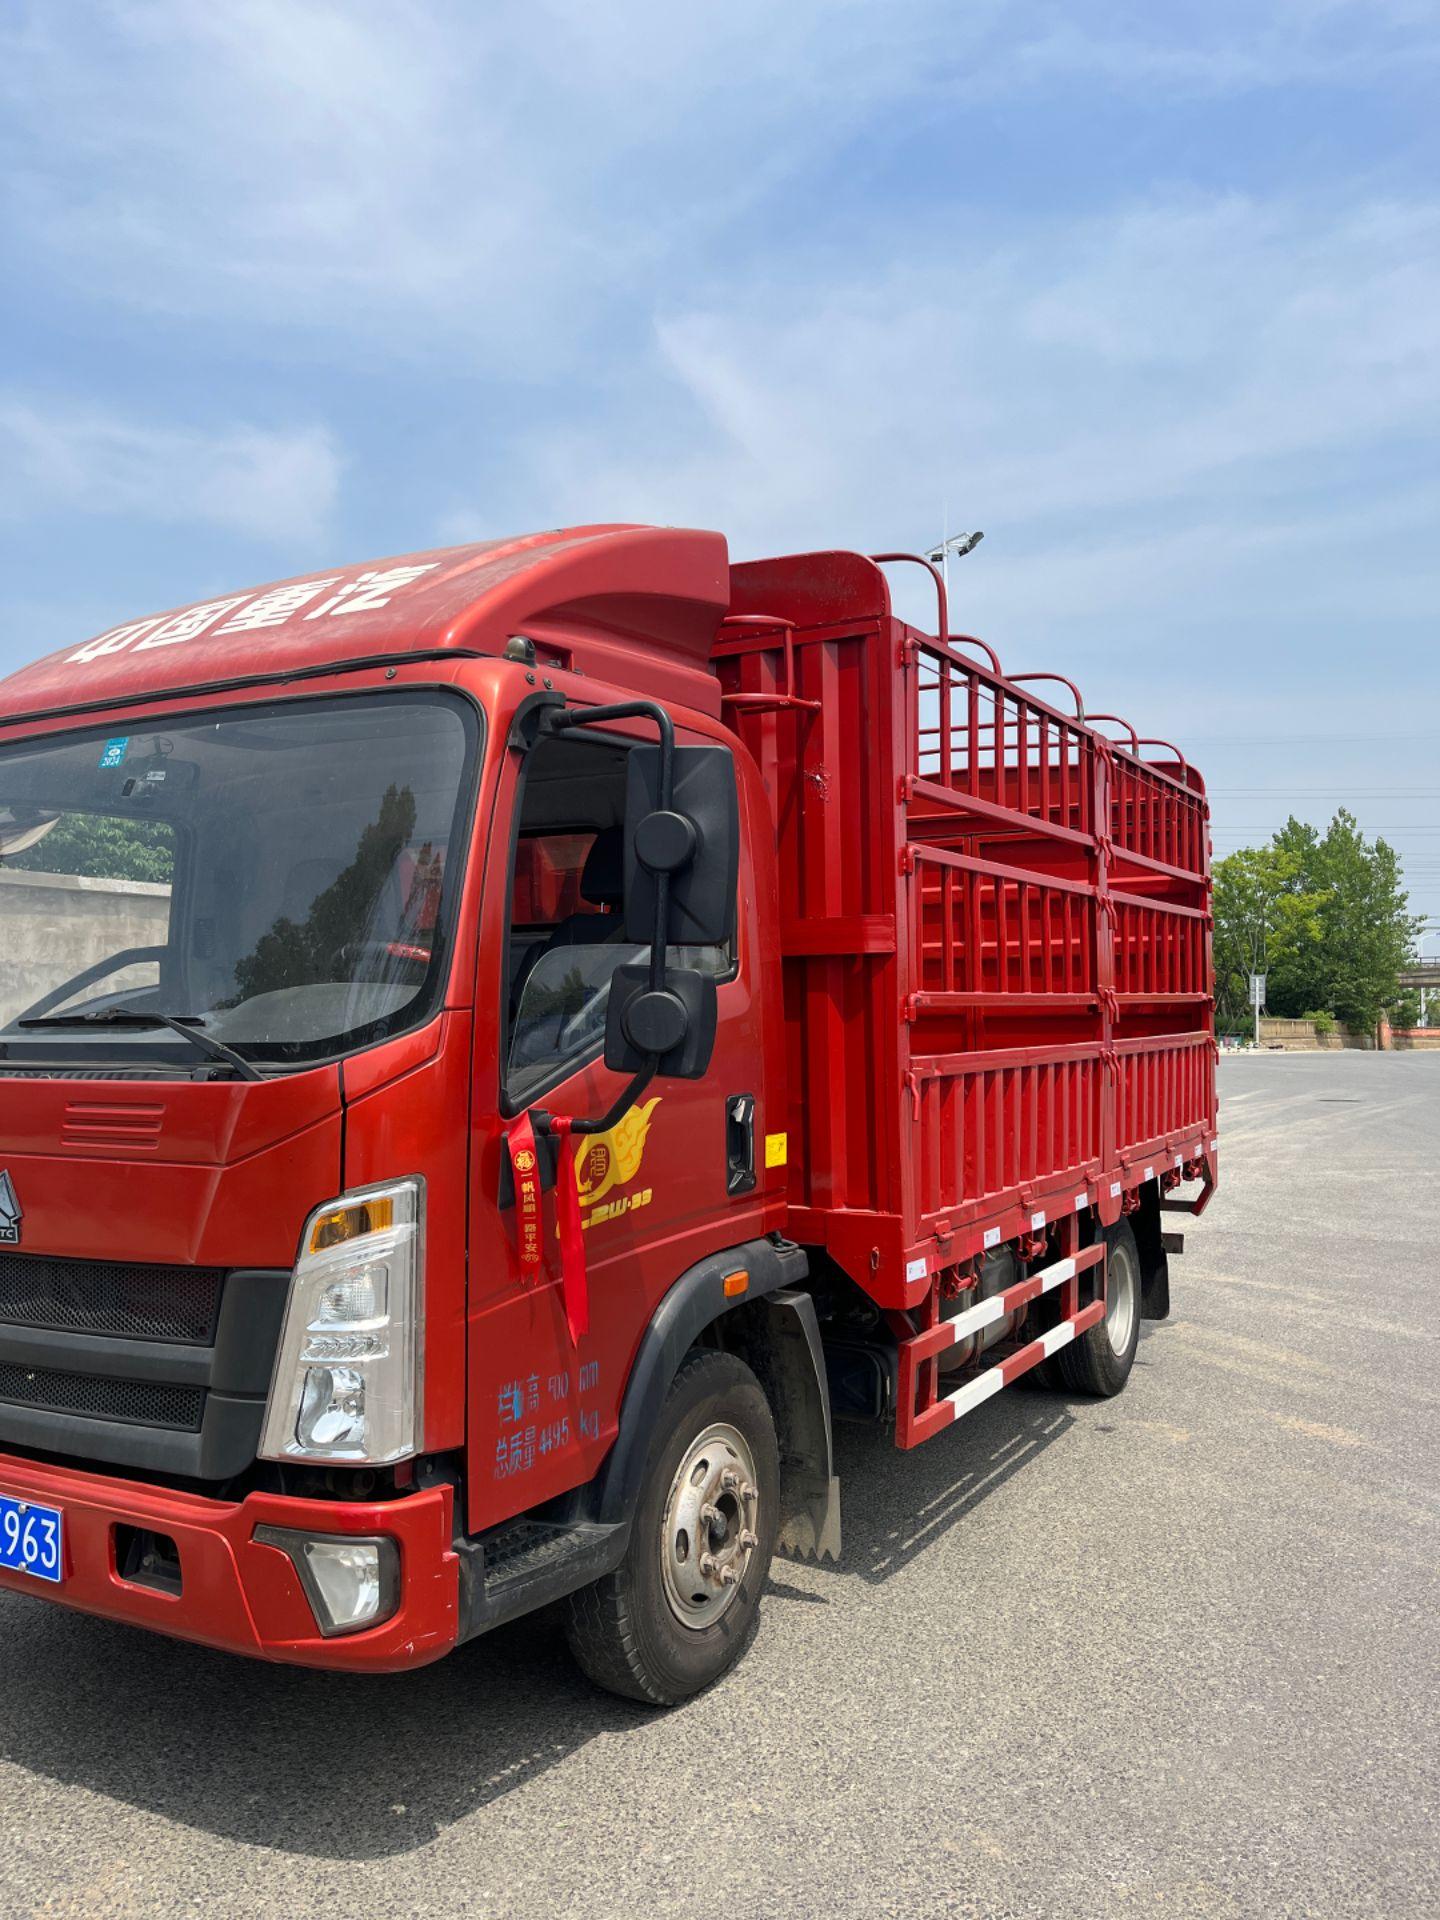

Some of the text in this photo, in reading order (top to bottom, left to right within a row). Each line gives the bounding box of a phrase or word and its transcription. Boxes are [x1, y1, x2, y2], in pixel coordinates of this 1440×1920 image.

[63, 562, 442, 664] 中国重汽
[0, 1506, 57, 1569] 963
